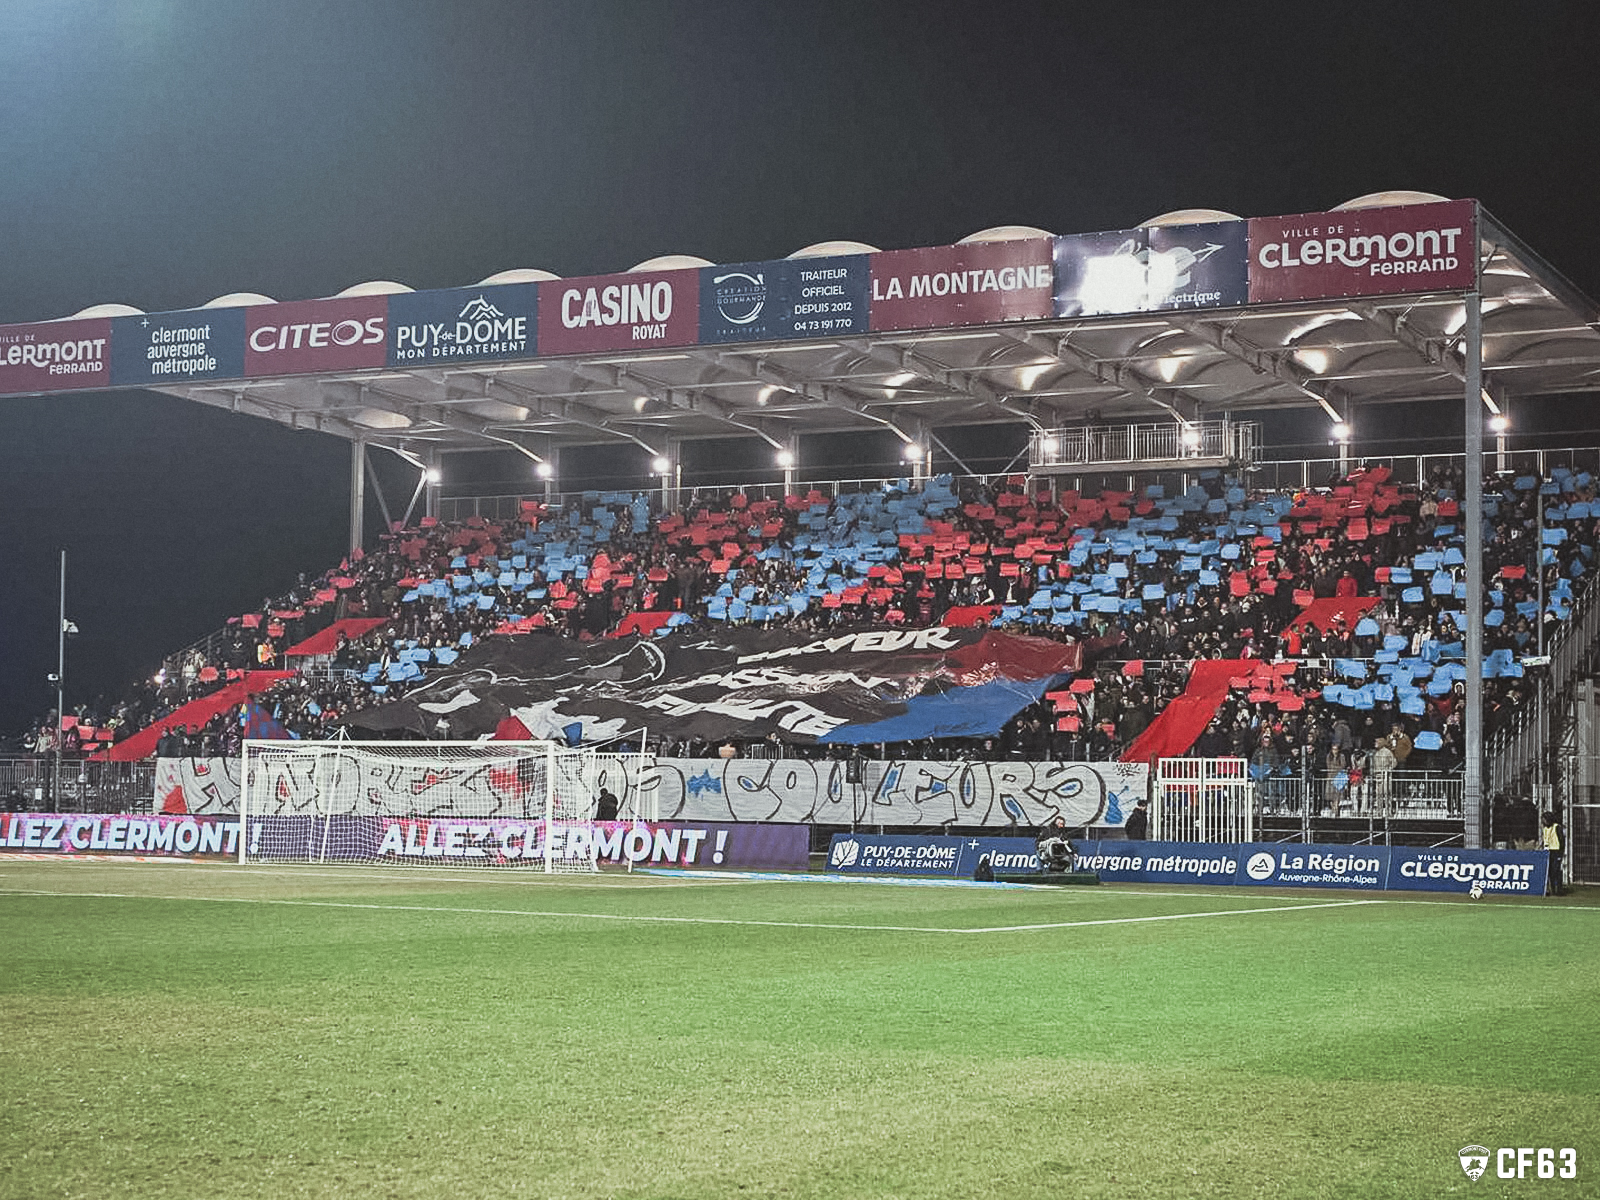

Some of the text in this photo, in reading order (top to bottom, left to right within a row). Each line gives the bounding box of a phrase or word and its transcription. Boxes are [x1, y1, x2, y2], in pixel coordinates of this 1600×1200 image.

[1282, 225, 1344, 238] VILLE DE
[801, 268, 848, 282] TRAITEUR
[872, 264, 1050, 301] LA MONTAGNE
[802, 285, 845, 298] OFFICIEL
[561, 281, 673, 329] CASINO
[794, 301, 852, 315] DEPUIS 2012
[632, 323, 667, 341] ROYAT
[794, 318, 852, 331] 04 73 191 770
[24, 333, 35, 342] DE
[152, 324, 211, 344] clermont
[250, 317, 384, 352] CITEOS
[0, 338, 106, 368] LeRmonT
[147, 342, 206, 359] auvergne
[397, 340, 526, 359] MON DÉPARTEMENT
[152, 354, 217, 375] métropole
[0, 818, 262, 855] LLEZ CLERMONT !
[377, 823, 728, 864] ALLEZ CLERMONT !
[863, 844, 958, 859] PUY-DE-DÔME
[860, 857, 955, 869] LE DÉPARTEMENT
[979, 849, 1038, 870] clermo
[1146, 855, 1237, 876] métropole
[1280, 853, 1380, 875] La Région
[1279, 873, 1378, 885] Auvergne-Rhône-Alpes
